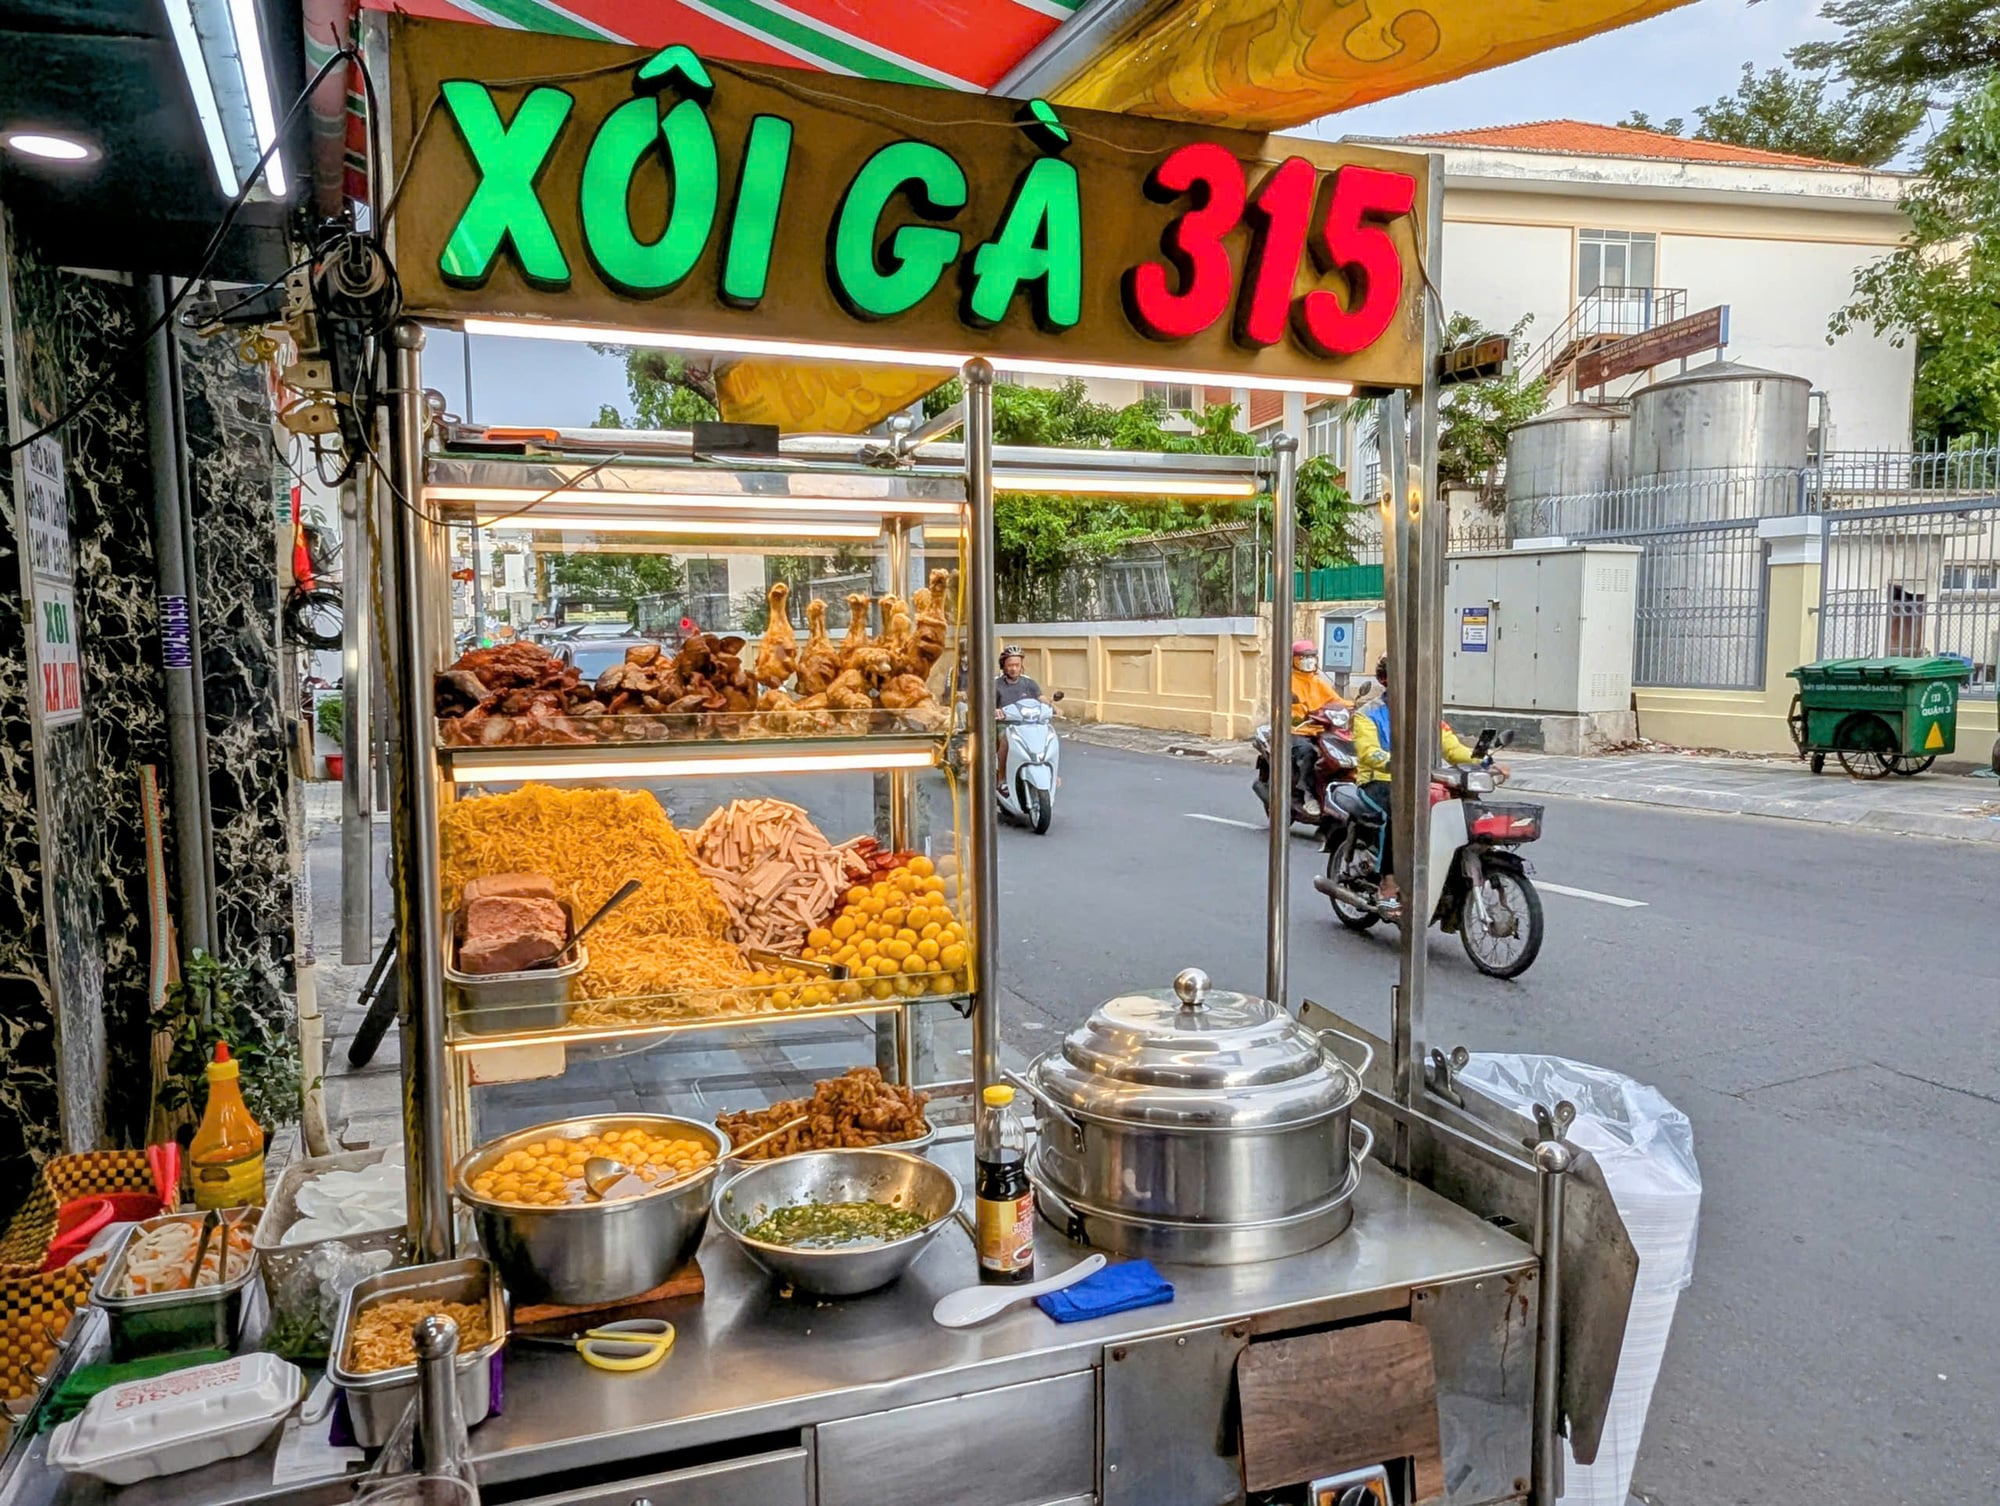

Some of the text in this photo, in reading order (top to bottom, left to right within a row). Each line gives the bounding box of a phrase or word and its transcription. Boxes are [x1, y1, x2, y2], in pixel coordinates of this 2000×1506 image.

[439, 45, 1416, 358] XÔI GÀ 315
[43, 591, 70, 644] XÔI
[43, 648, 61, 713] XÁ
